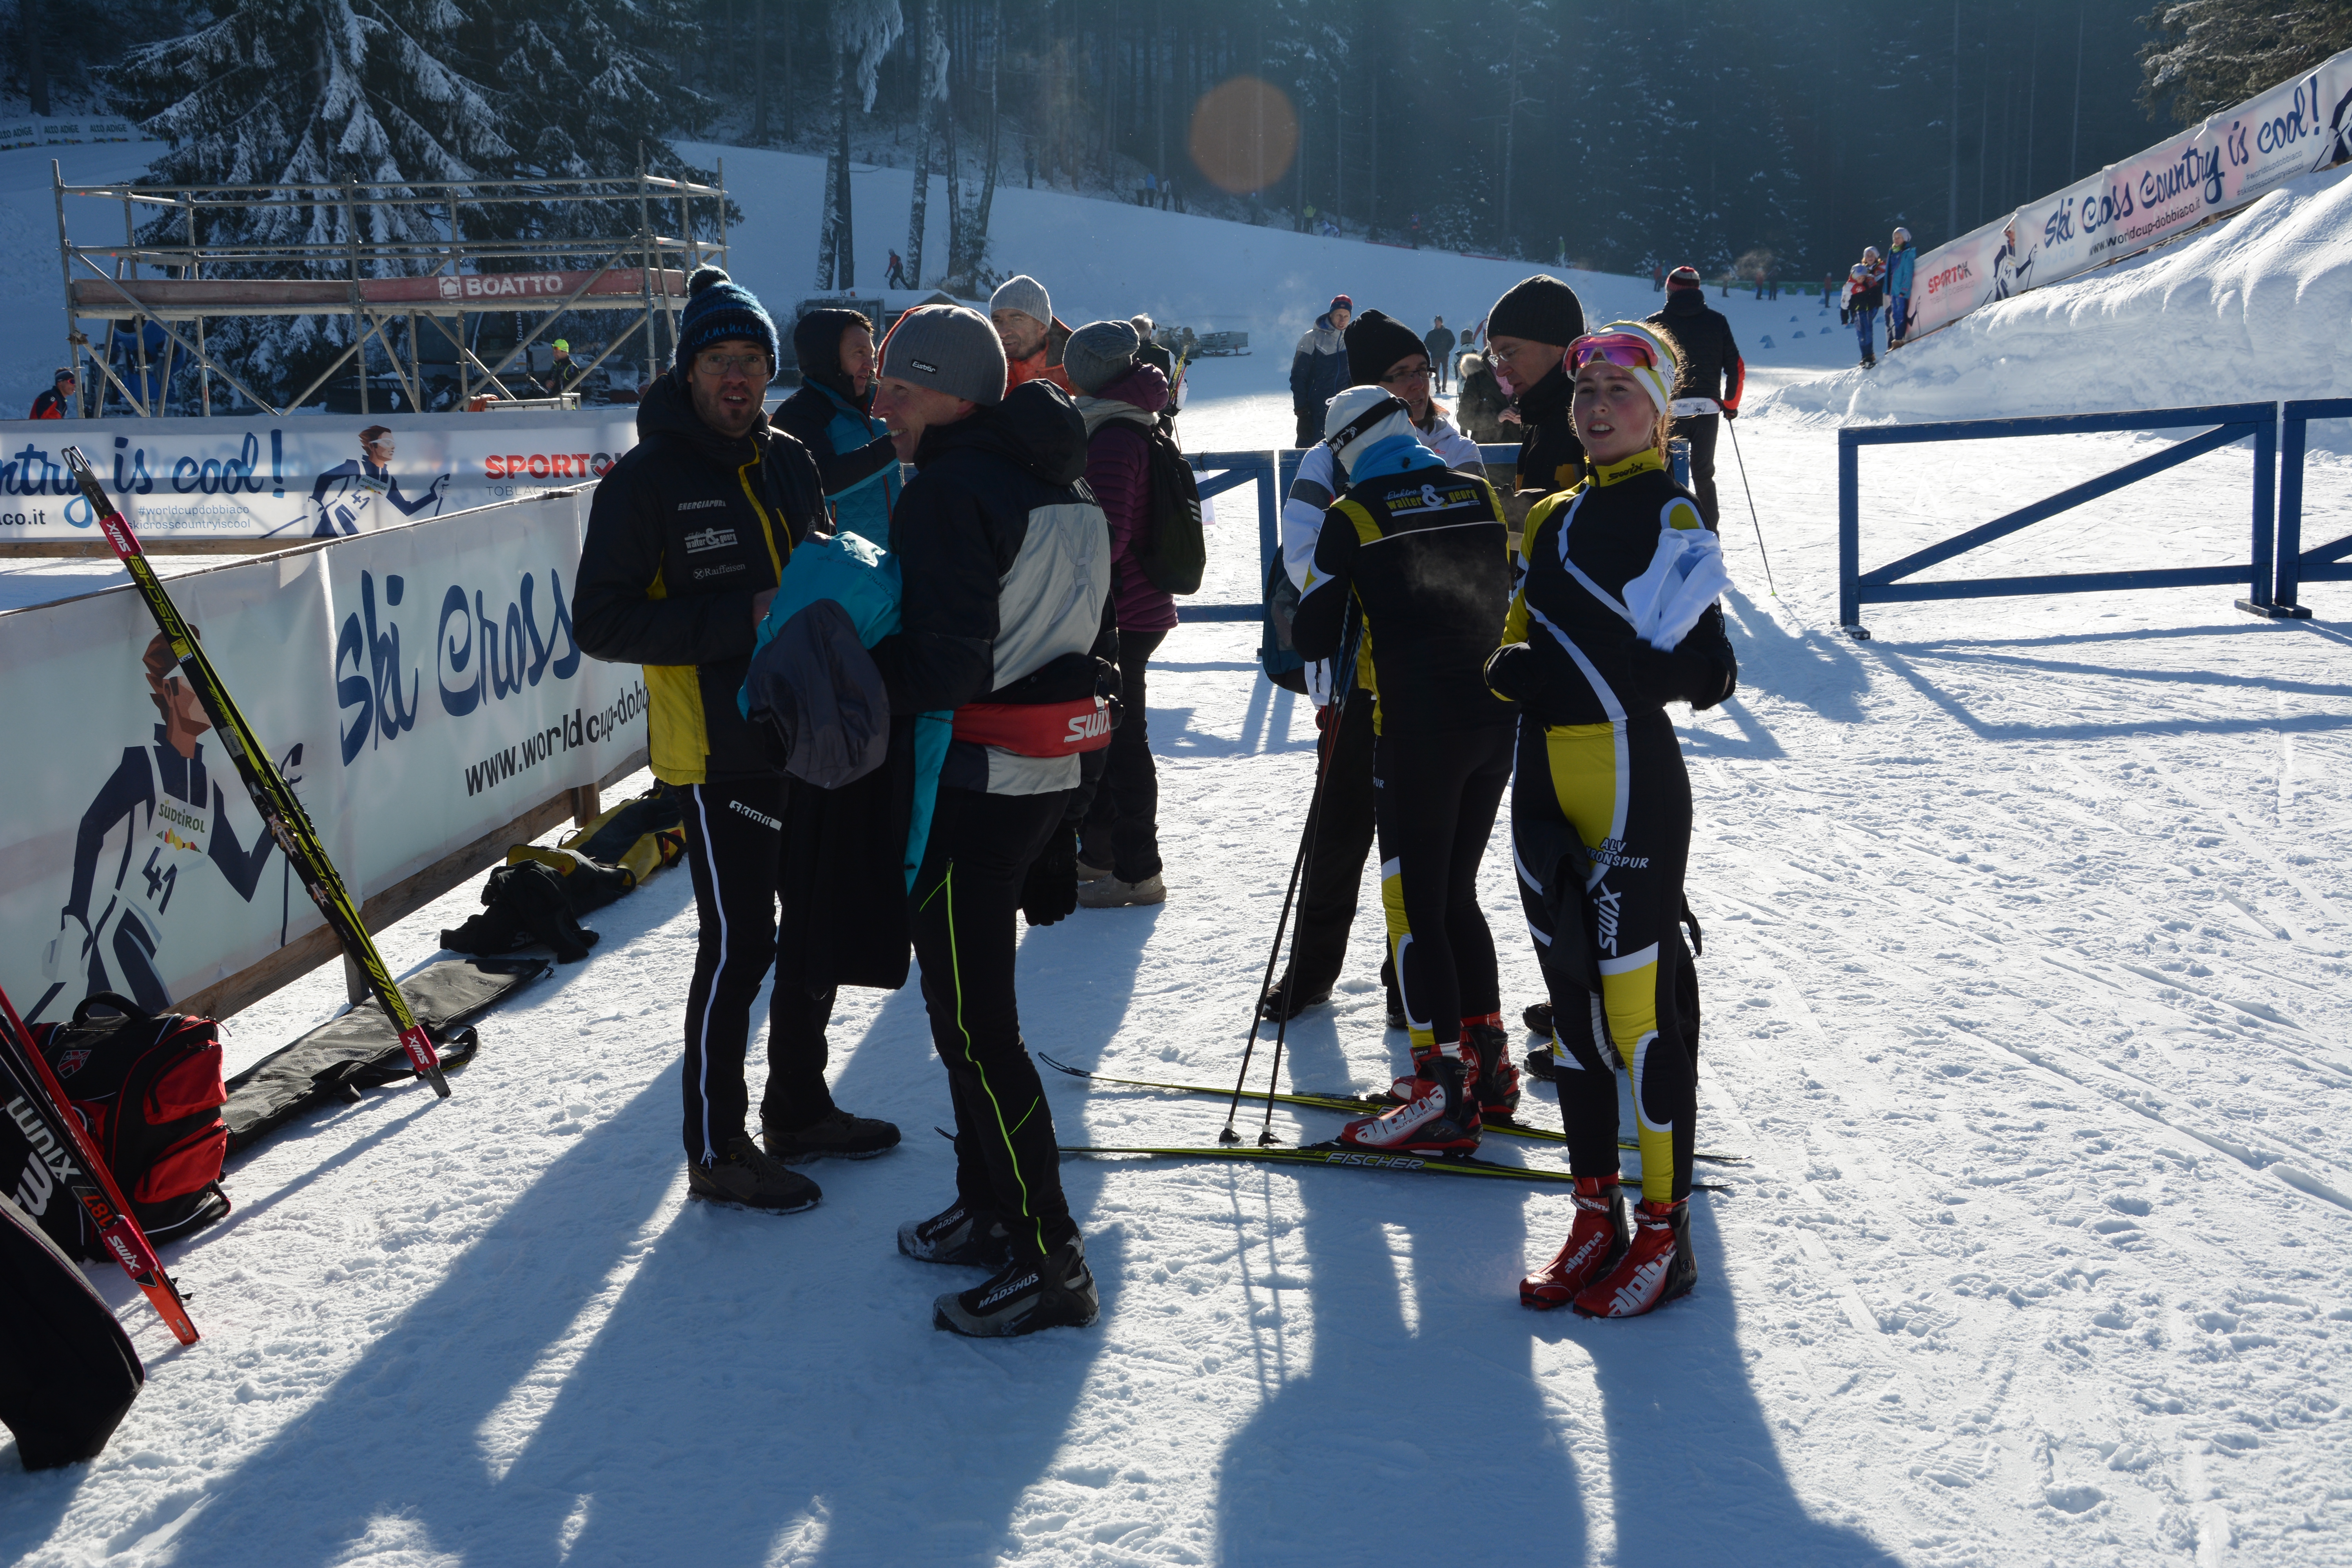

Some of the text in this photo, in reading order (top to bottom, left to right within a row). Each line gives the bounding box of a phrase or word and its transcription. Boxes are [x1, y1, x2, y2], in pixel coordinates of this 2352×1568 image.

[2140, 145, 2225, 204] Country
[2228, 121, 2249, 166] is
[466, 275, 563, 296] BOATTO
[913, 361, 936, 373] Eisbär
[113, 437, 154, 495] is
[1386, 484, 1478, 510] walter & georg
[1388, 489, 1417, 500] Elektro
[138, 505, 250, 516] #worldcupdobbiaco
[686, 538, 706, 549] walter
[704, 563, 746, 576] Raiffeisen
[437, 568, 581, 717] Cross
[1600, 837, 1626, 852] ALV
[142, 846, 178, 916] 41
[1325, 1153, 1425, 1170] FISCHER
[926, 1207, 966, 1237] MADSHUS
[1565, 1231, 1604, 1274] alpina
[978, 1273, 1039, 1309] MADSHUS
